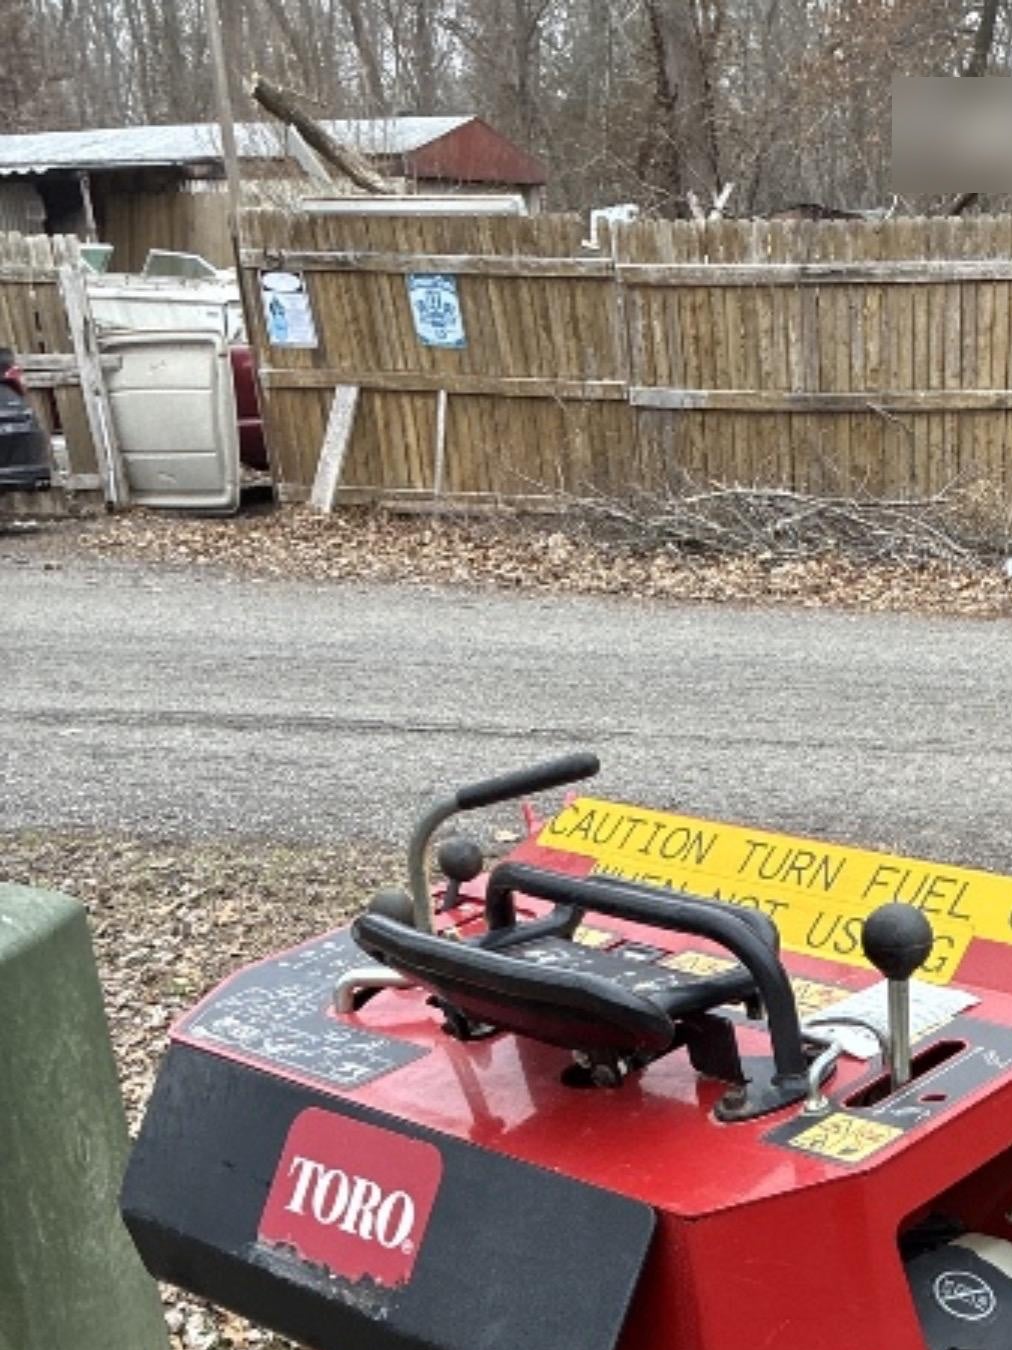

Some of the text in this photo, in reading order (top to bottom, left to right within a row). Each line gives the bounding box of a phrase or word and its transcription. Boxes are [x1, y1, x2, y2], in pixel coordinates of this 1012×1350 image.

[549, 804, 718, 865] CAUTION
[738, 840, 847, 892] TURN
[861, 865, 972, 921] FUEL
[806, 912, 954, 973] USG
[284, 1156, 415, 1249] TORO
